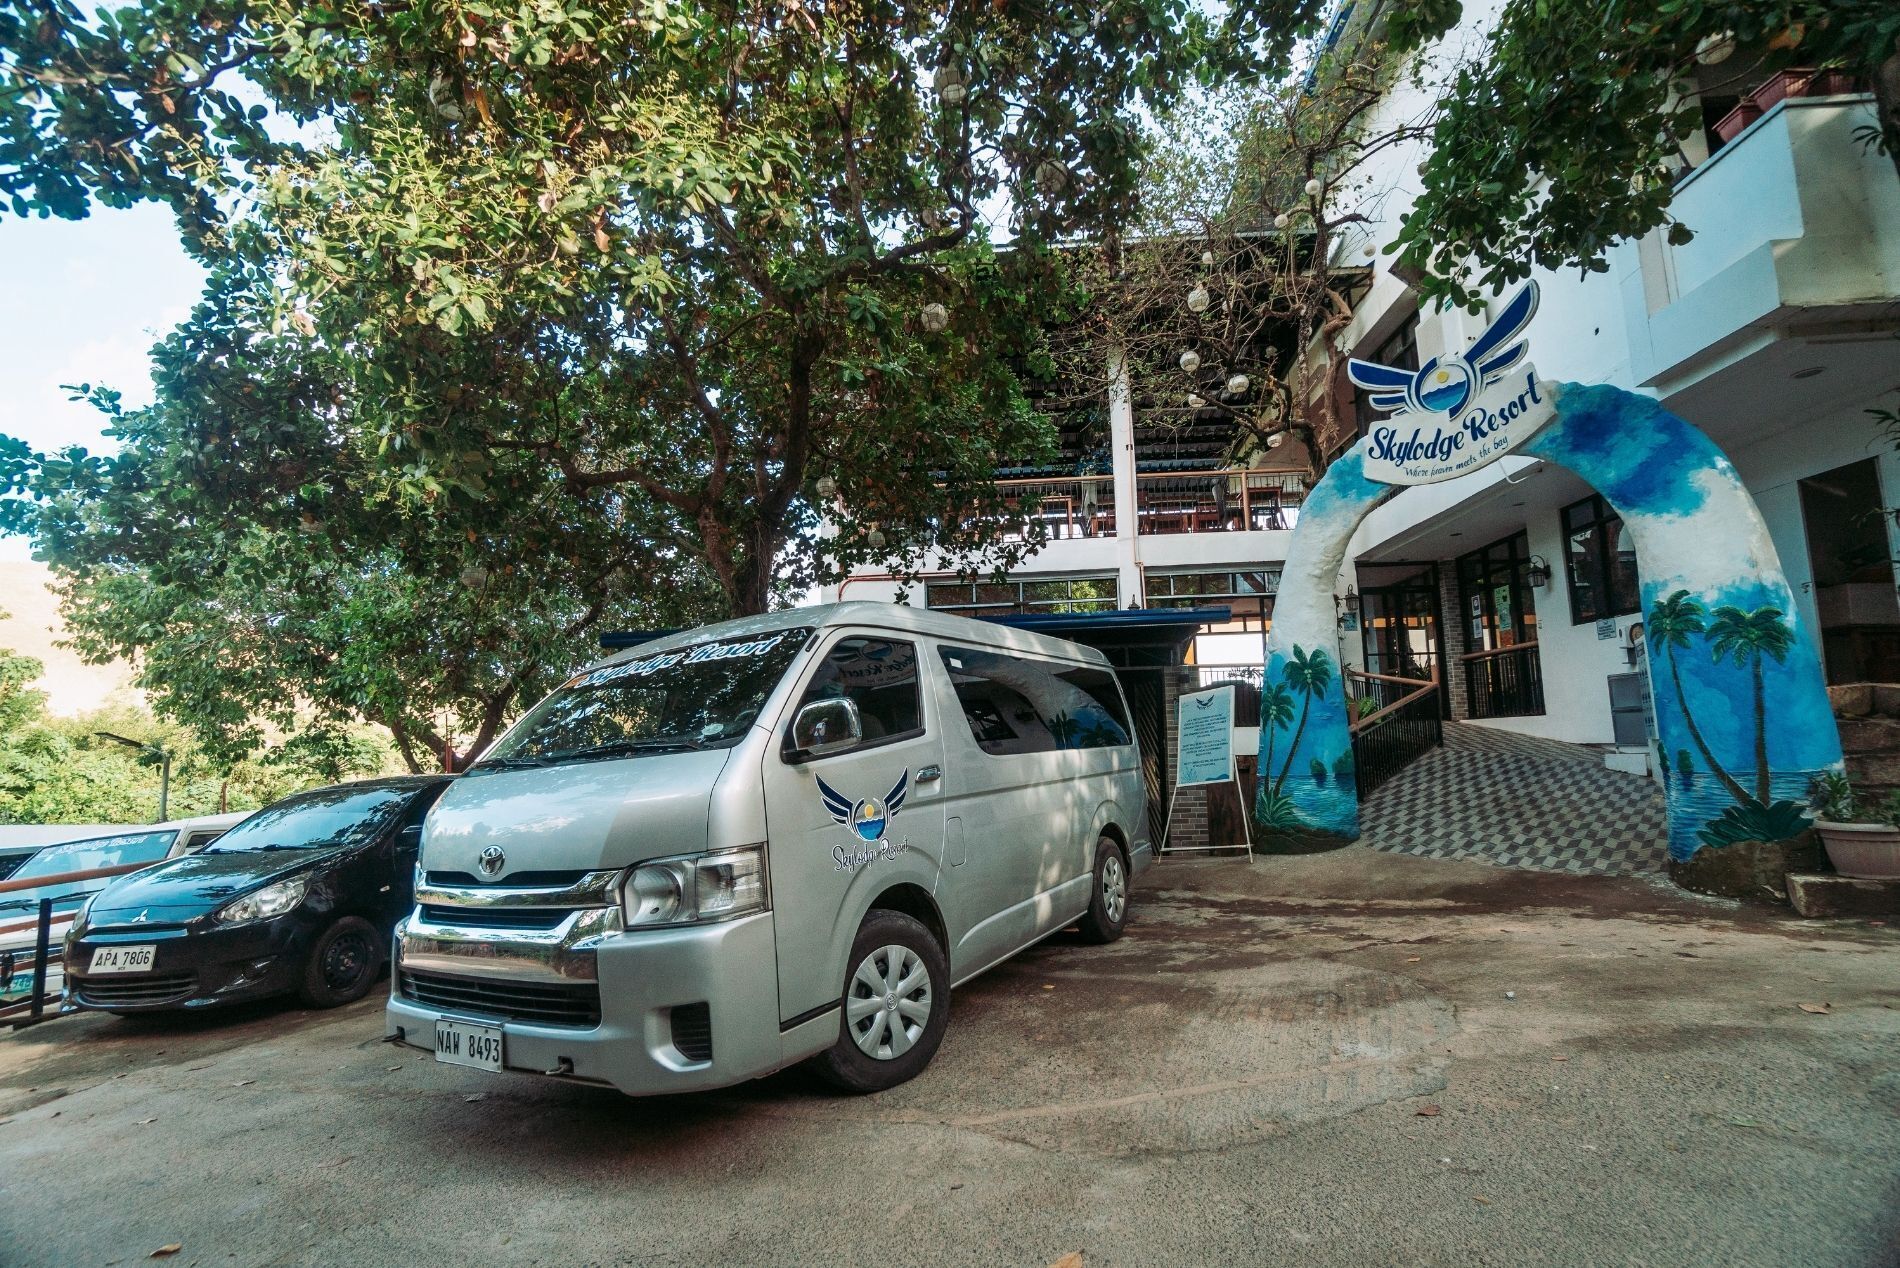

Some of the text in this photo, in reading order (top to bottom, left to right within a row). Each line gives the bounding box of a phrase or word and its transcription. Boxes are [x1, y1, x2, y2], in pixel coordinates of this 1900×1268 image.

[1368, 371, 1542, 467] Skylodge Resort
[1456, 455, 1477, 469] meets
[1480, 442, 1491, 459] the
[1493, 436, 1509, 450] bay
[683, 635, 783, 665] Resort
[832, 835, 909, 873] Skylodge Resort
[95, 950, 151, 967] APA 7806
[437, 1029, 500, 1063] NAW 8493
